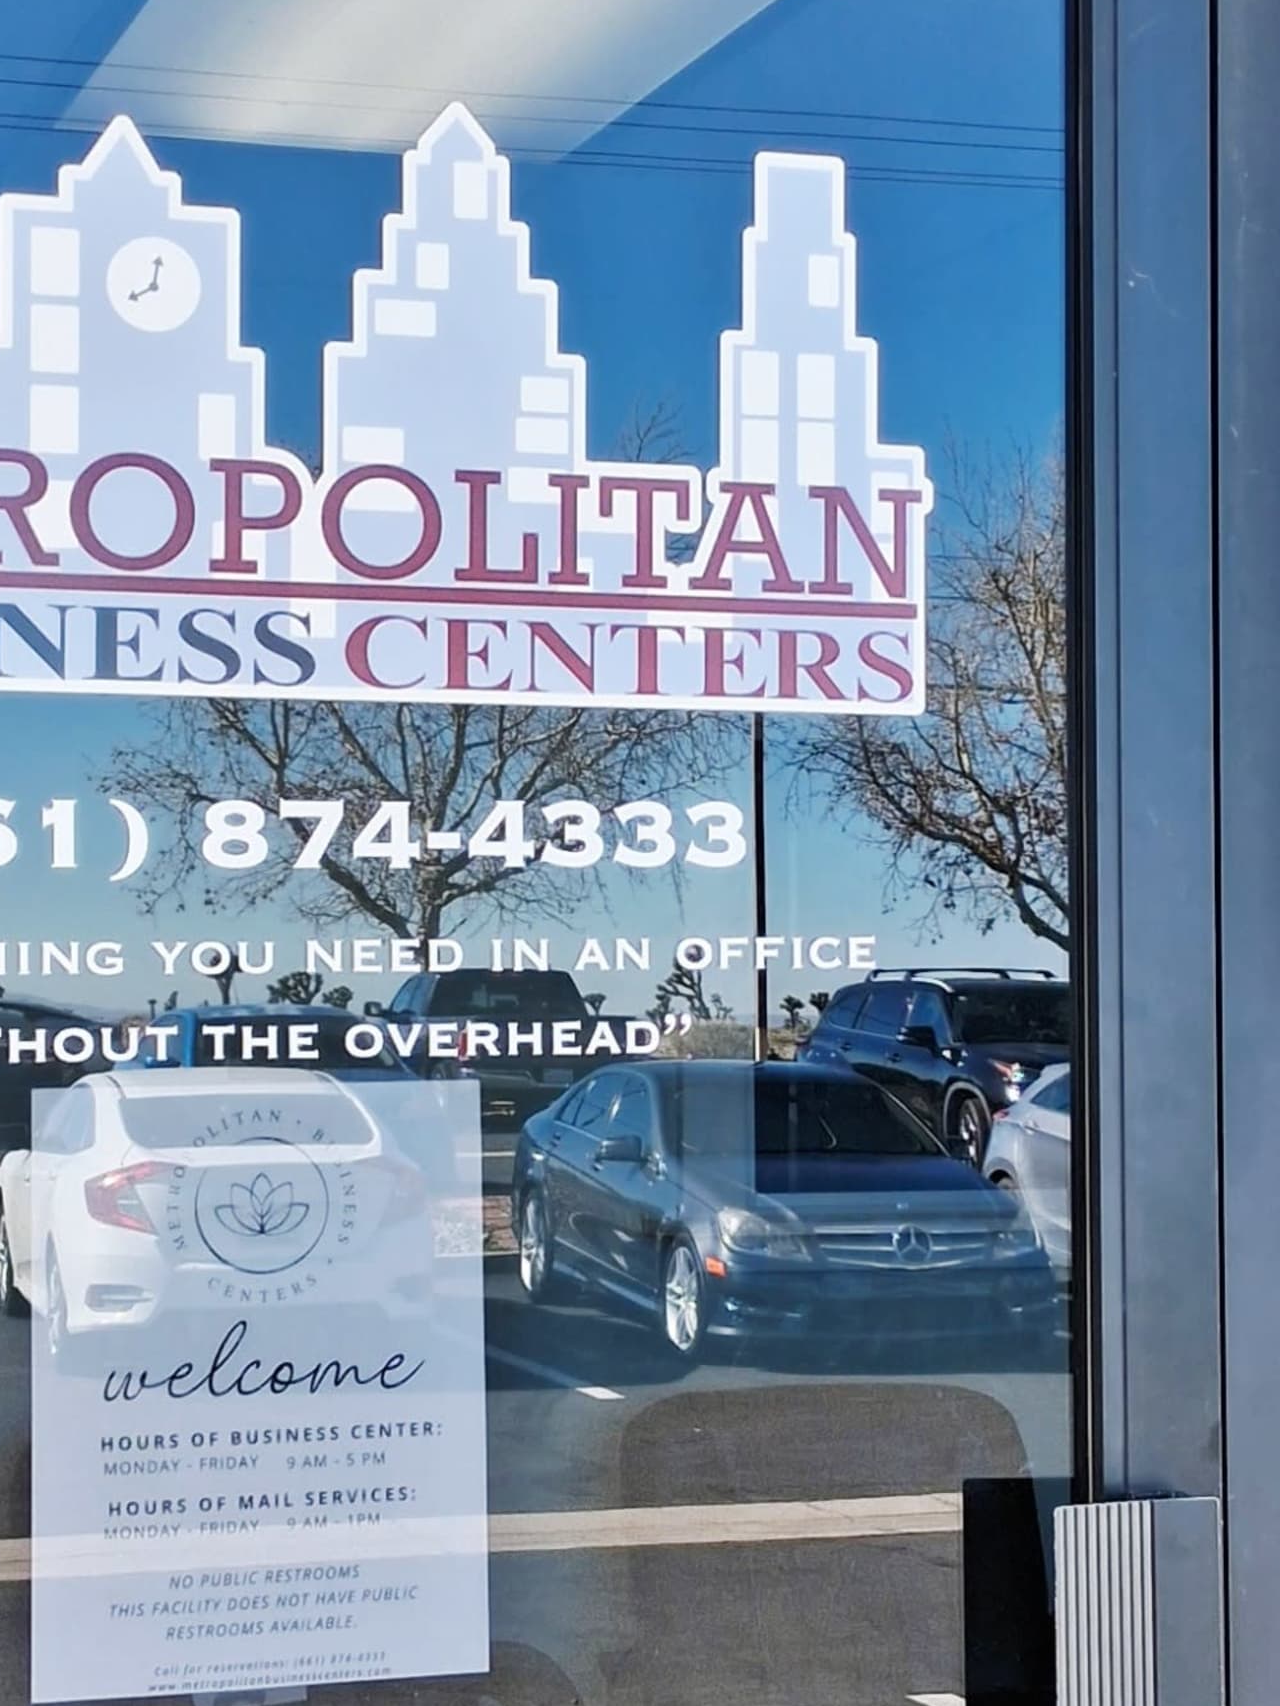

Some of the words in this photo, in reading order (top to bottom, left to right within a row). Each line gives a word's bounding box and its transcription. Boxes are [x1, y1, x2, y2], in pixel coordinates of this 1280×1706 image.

[344, 613, 914, 705] CENTERS
[201, 796, 749, 871] 874-4333
[151, 940, 275, 976] YOU
[306, 936, 464, 973] NEED
[491, 938, 550, 972] IN
[574, 937, 651, 971] AN
[676, 935, 878, 971] OFFICE
[203, 1022, 320, 1060] THE
[167, 1109, 283, 1251] METROOLITAN
[312, 1127, 358, 1245] BINESS
[208, 1274, 318, 1304] CENTERS
[103, 1320, 424, 1402] welcome
[100, 1434, 179, 1452] HOURS
[191, 1431, 220, 1448] OF
[230, 1426, 340, 1446] BUSINESS
[351, 1421, 443, 1440] CENTER:
[103, 1458, 181, 1476] MONDAY
[199, 1454, 259, 1471] FRIDAY
[286, 1456, 296, 1470] 9
[302, 1453, 328, 1469] AM
[346, 1453, 355, 1467] 5
[361, 1451, 387, 1466] PM
[108, 1498, 187, 1517] HOURS
[199, 1496, 227, 1512] OF
[238, 1493, 294, 1510] MAIL
[304, 1486, 417, 1506] SERVICES:
[103, 1524, 181, 1540] MONDAY
[199, 1519, 260, 1535] FRIDAY
[302, 1514, 328, 1529] AM
[169, 1575, 194, 1590] NO
[200, 1571, 258, 1588] PUBLIC
[264, 1564, 361, 1583] RESTROOMS
[109, 1603, 145, 1618] THIS
[151, 1599, 222, 1616] FACILITY
[227, 1595, 270, 1611] DOES
[276, 1592, 309, 1608] NOT
[315, 1589, 357, 1605] HAVE
[361, 1585, 418, 1602] PUBLIC
[166, 1621, 264, 1641] RESTROOMS
[270, 1615, 358, 1633] AVAILABLE.
